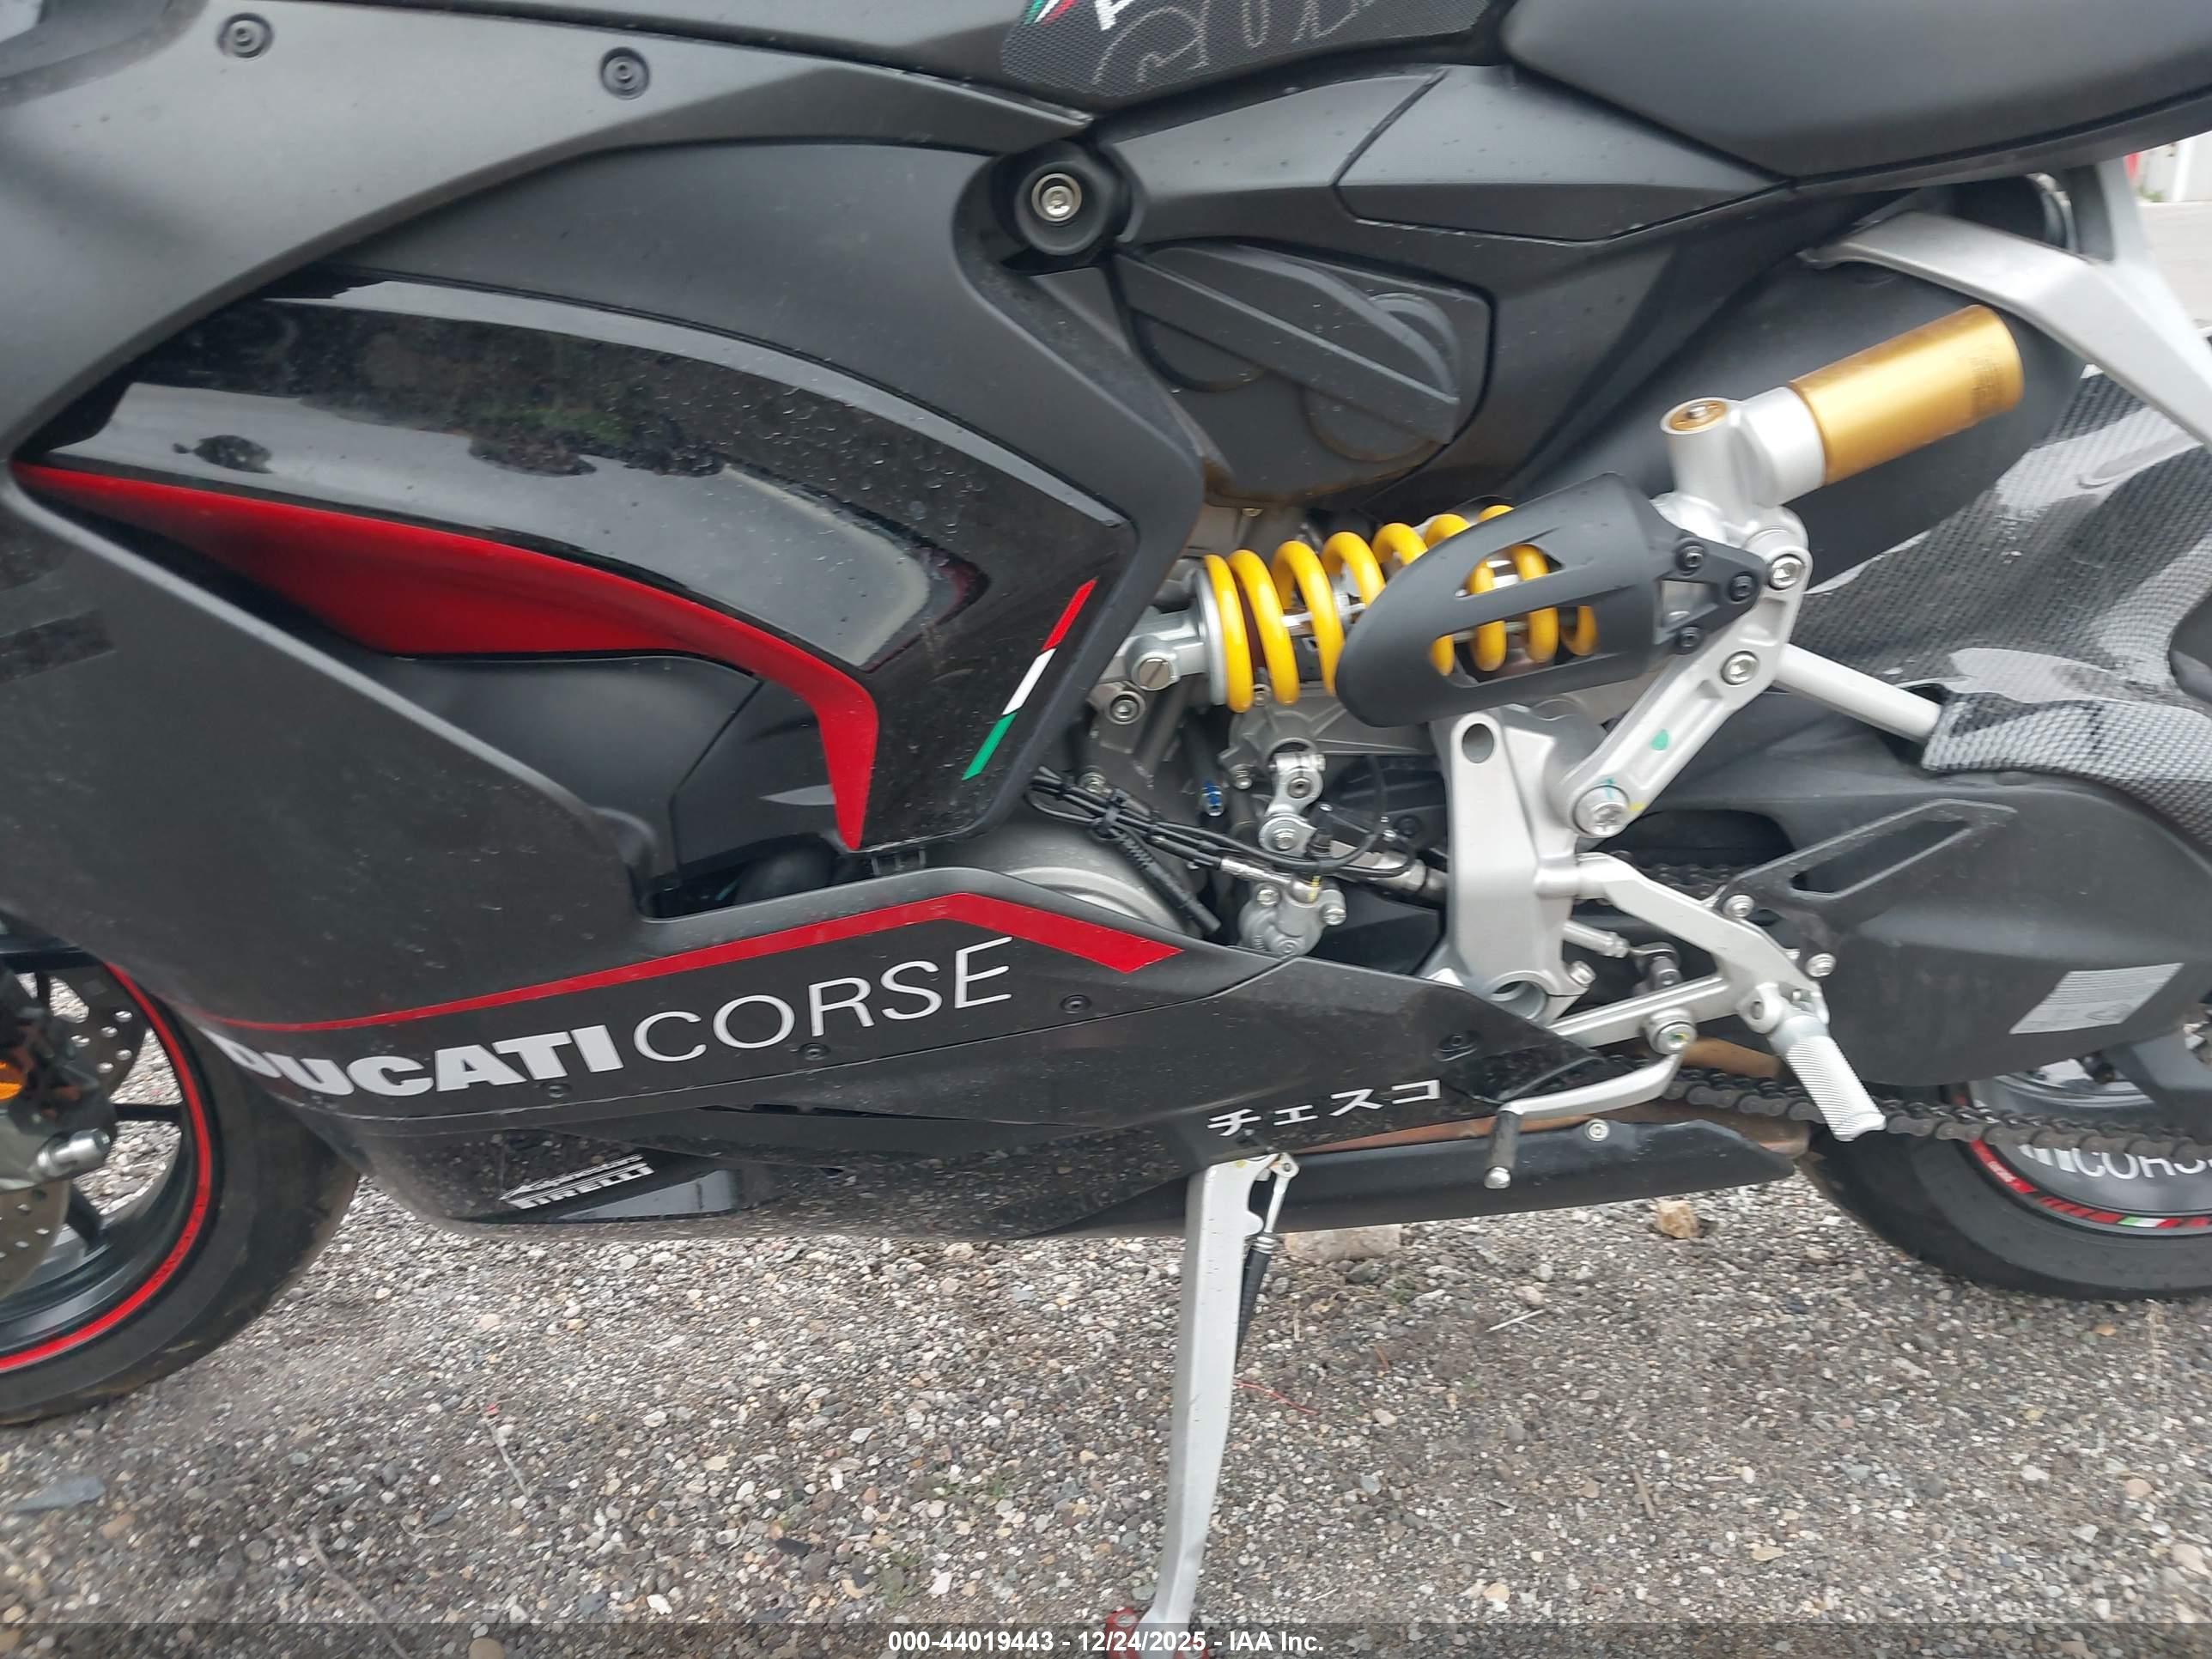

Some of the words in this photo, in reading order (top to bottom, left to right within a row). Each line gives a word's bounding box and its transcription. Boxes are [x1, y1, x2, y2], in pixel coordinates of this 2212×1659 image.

[199, 1025, 623, 1097] DUCATI
[633, 936, 1014, 1062] CORSE
[1206, 1079, 1441, 1137] チェスコ
[507, 1162, 655, 1210] PIRELLI
